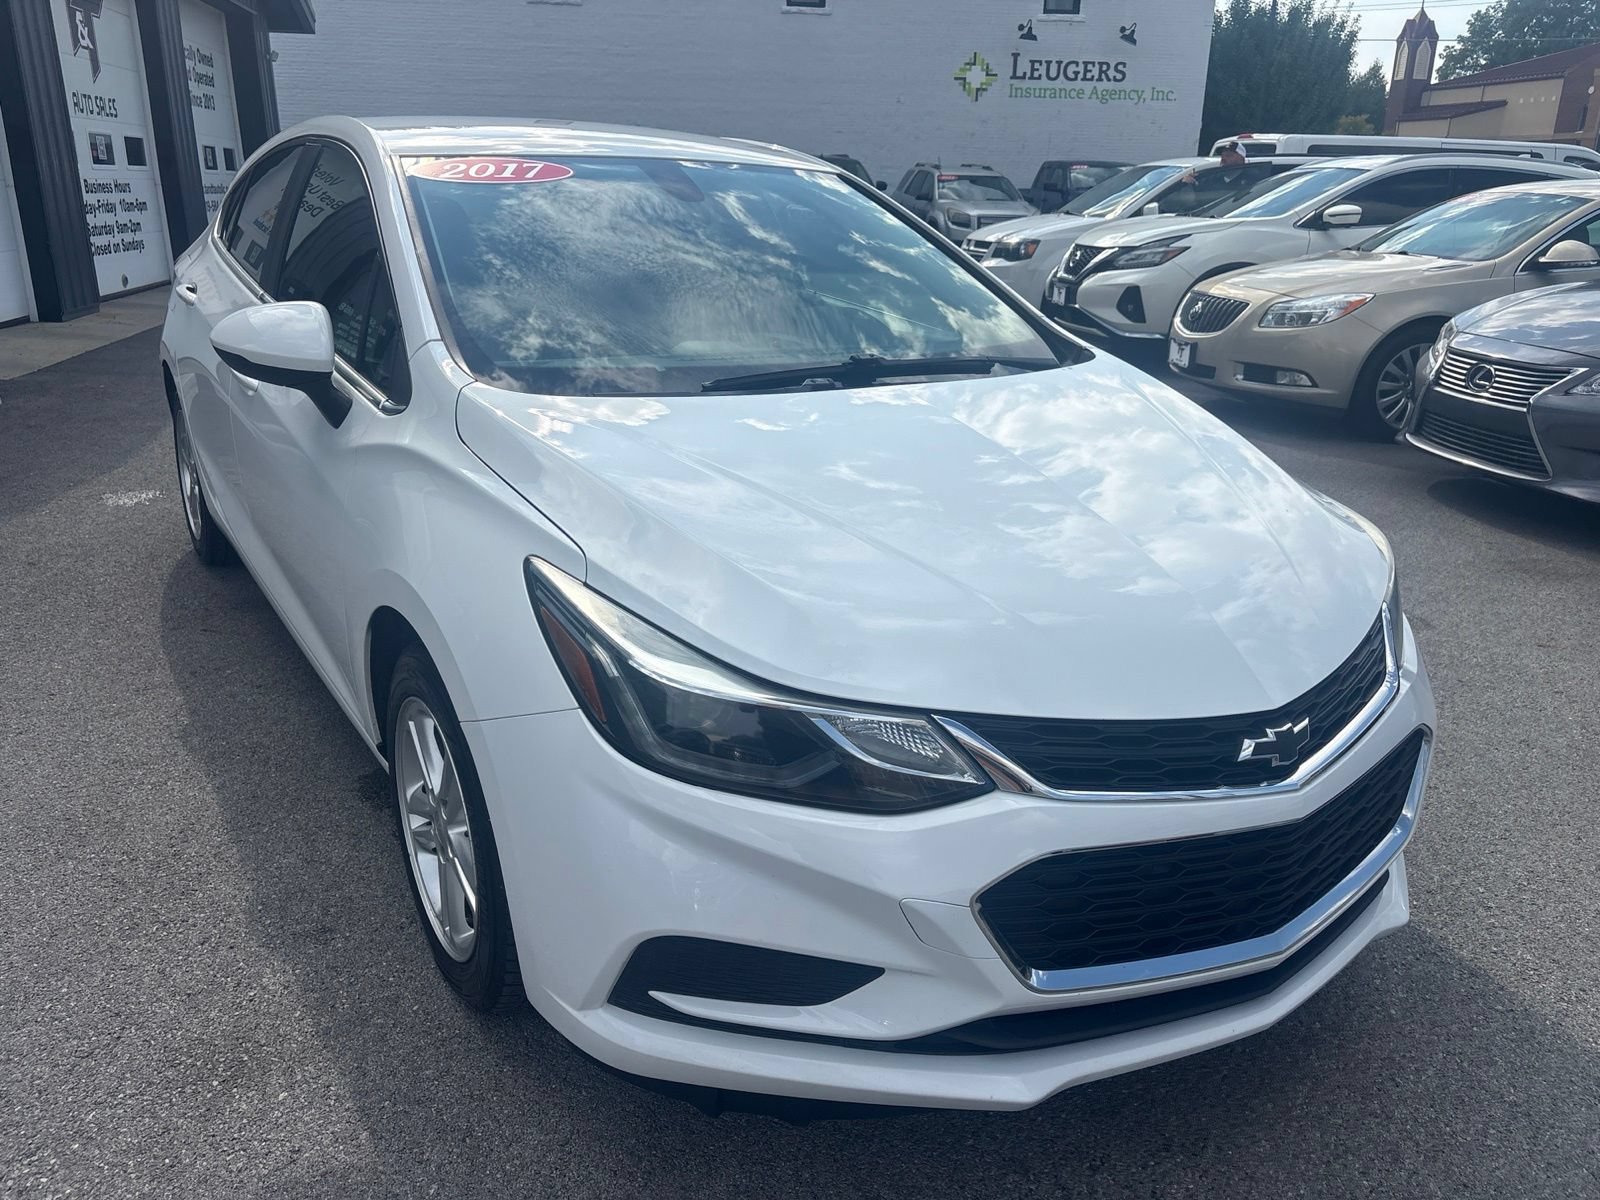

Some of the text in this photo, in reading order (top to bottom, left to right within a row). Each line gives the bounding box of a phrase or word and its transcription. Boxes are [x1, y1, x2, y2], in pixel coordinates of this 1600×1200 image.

[197, 47, 214, 69] Owned
[1009, 52, 1128, 83] LEUGERS
[193, 66, 215, 89] Operated
[72, 90, 118, 119] AUTO SALES
[1008, 84, 1177, 105] Insurance Agency, Inc.
[439, 162, 545, 179] 2017
[83, 179, 131, 194] Business Hours
[87, 221, 115, 239] Saturday
[113, 243, 121, 254] on
[121, 237, 145, 254] Sundays
